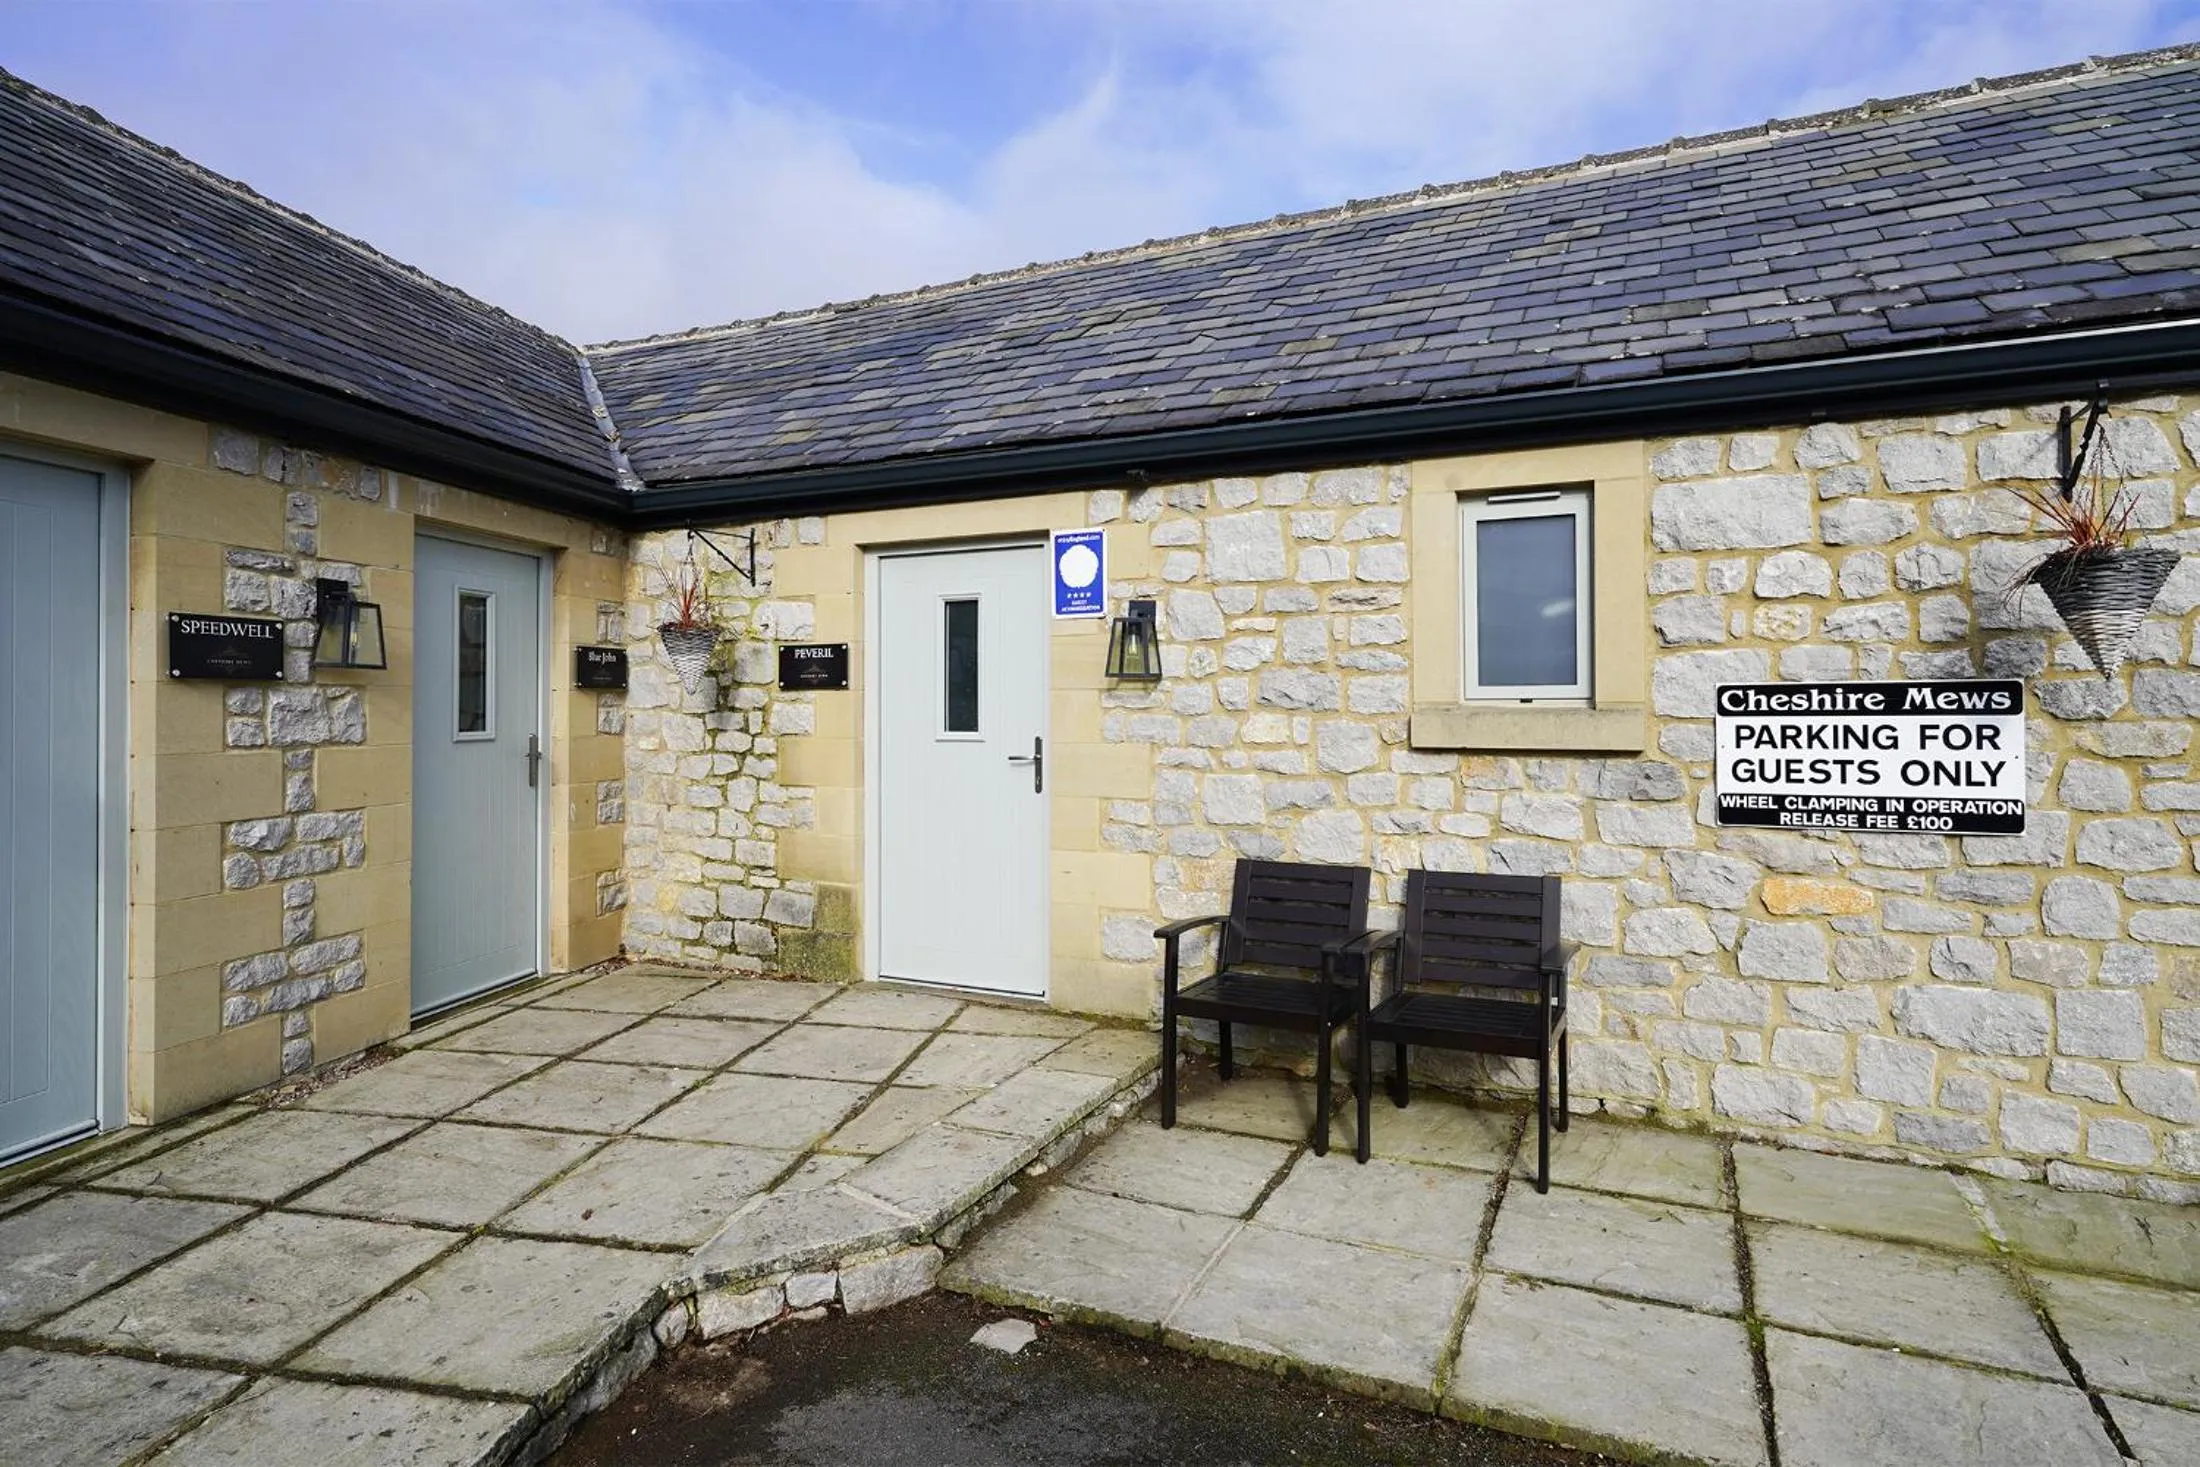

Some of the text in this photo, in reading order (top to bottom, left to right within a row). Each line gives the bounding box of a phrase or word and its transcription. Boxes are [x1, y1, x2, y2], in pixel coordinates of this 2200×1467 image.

[181, 620, 274, 638] SPEEDWELL
[602, 652, 616, 664] John
[794, 648, 834, 659] PEVERIL
[1721, 687, 2012, 712] Cheshire Mews
[1735, 724, 2001, 750] PARKING FOR
[1731, 758, 2007, 787] GUESTS ONLY
[1721, 796, 2023, 815] WHEEL CLAMPING IN OPERATION
[1780, 811, 1953, 830] RELEASE FEE £100
